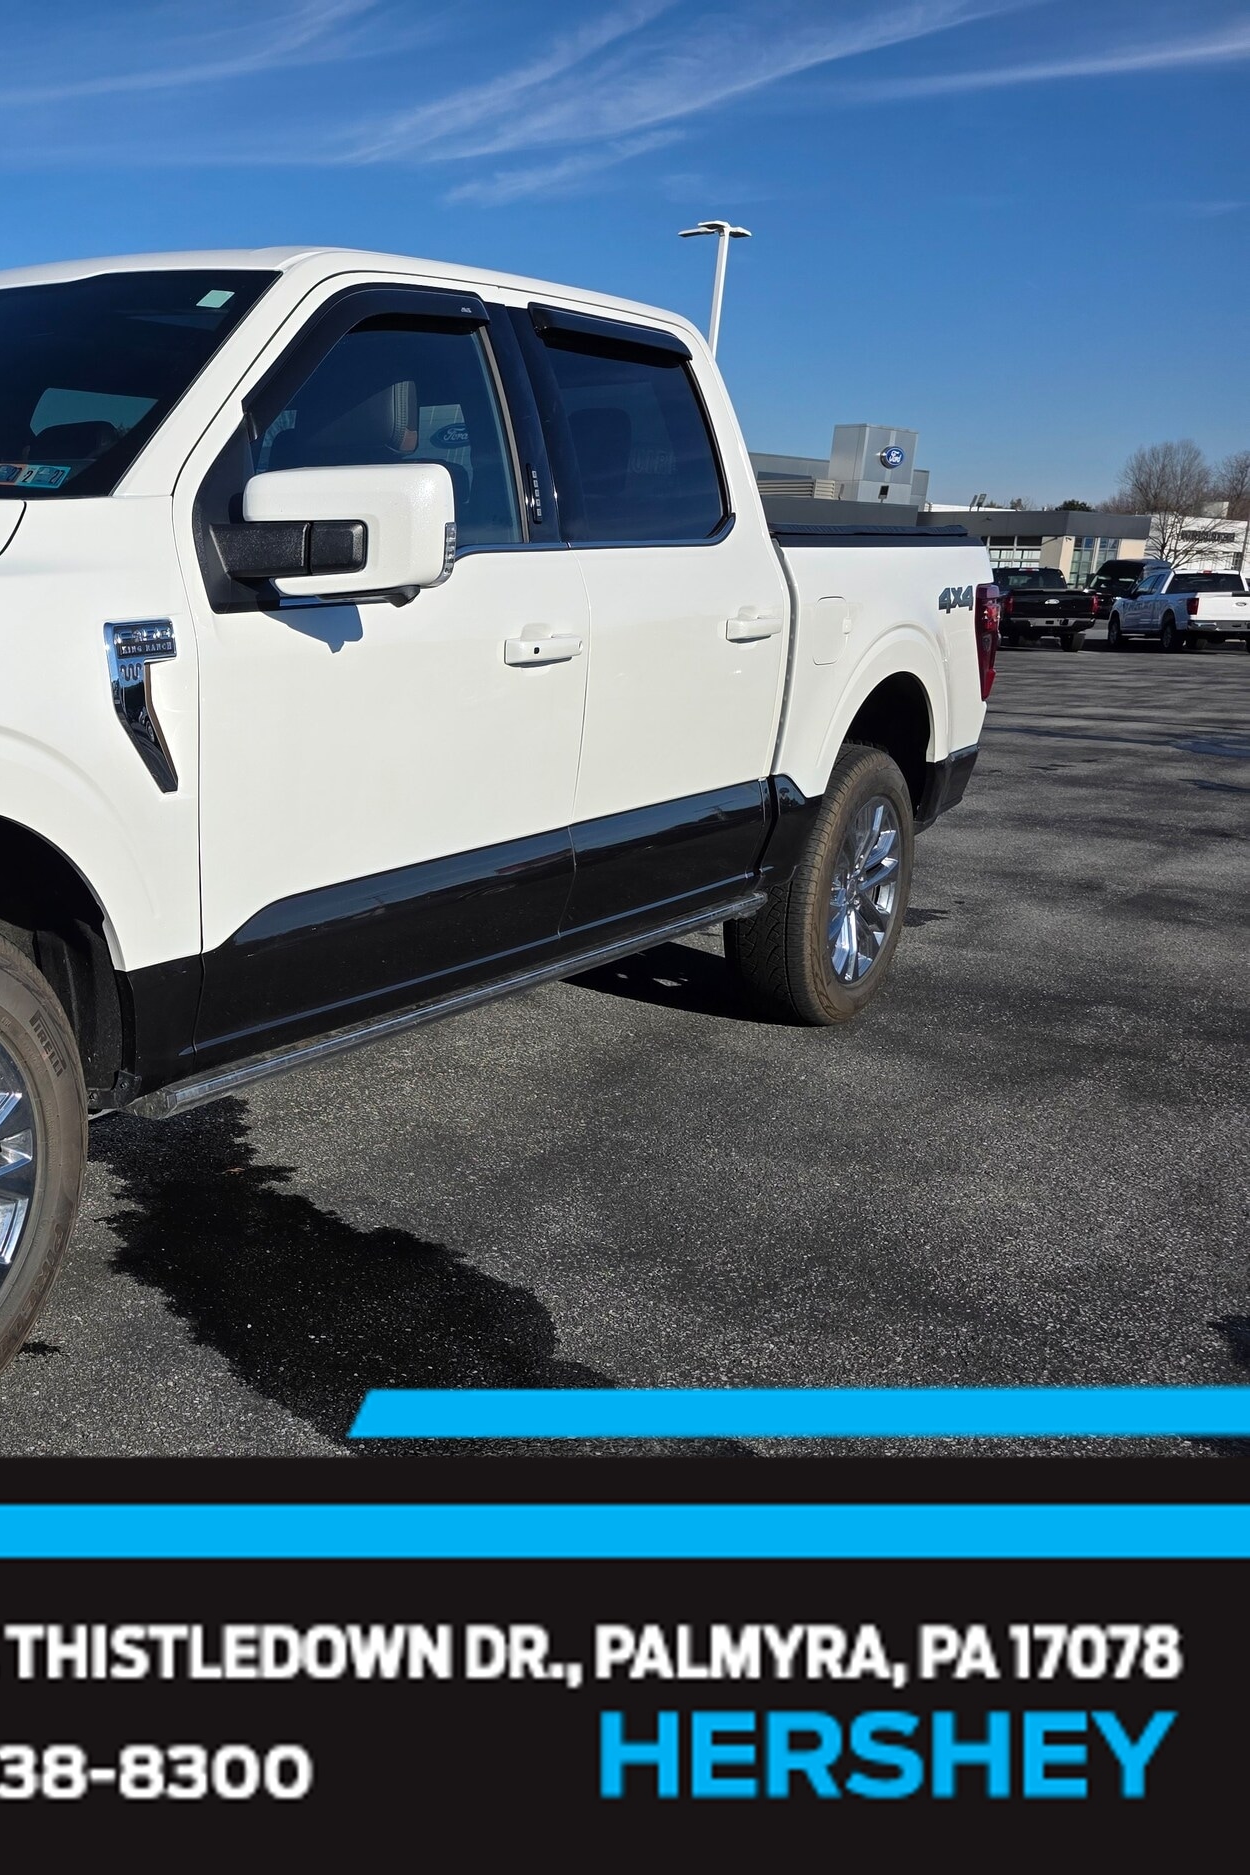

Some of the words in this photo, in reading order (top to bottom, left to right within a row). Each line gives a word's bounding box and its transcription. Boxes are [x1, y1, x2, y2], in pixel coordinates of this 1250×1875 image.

[121, 645, 143, 655] KING
[145, 641, 172, 652] RANCH
[29, 1009, 68, 1078] PIRELLI
